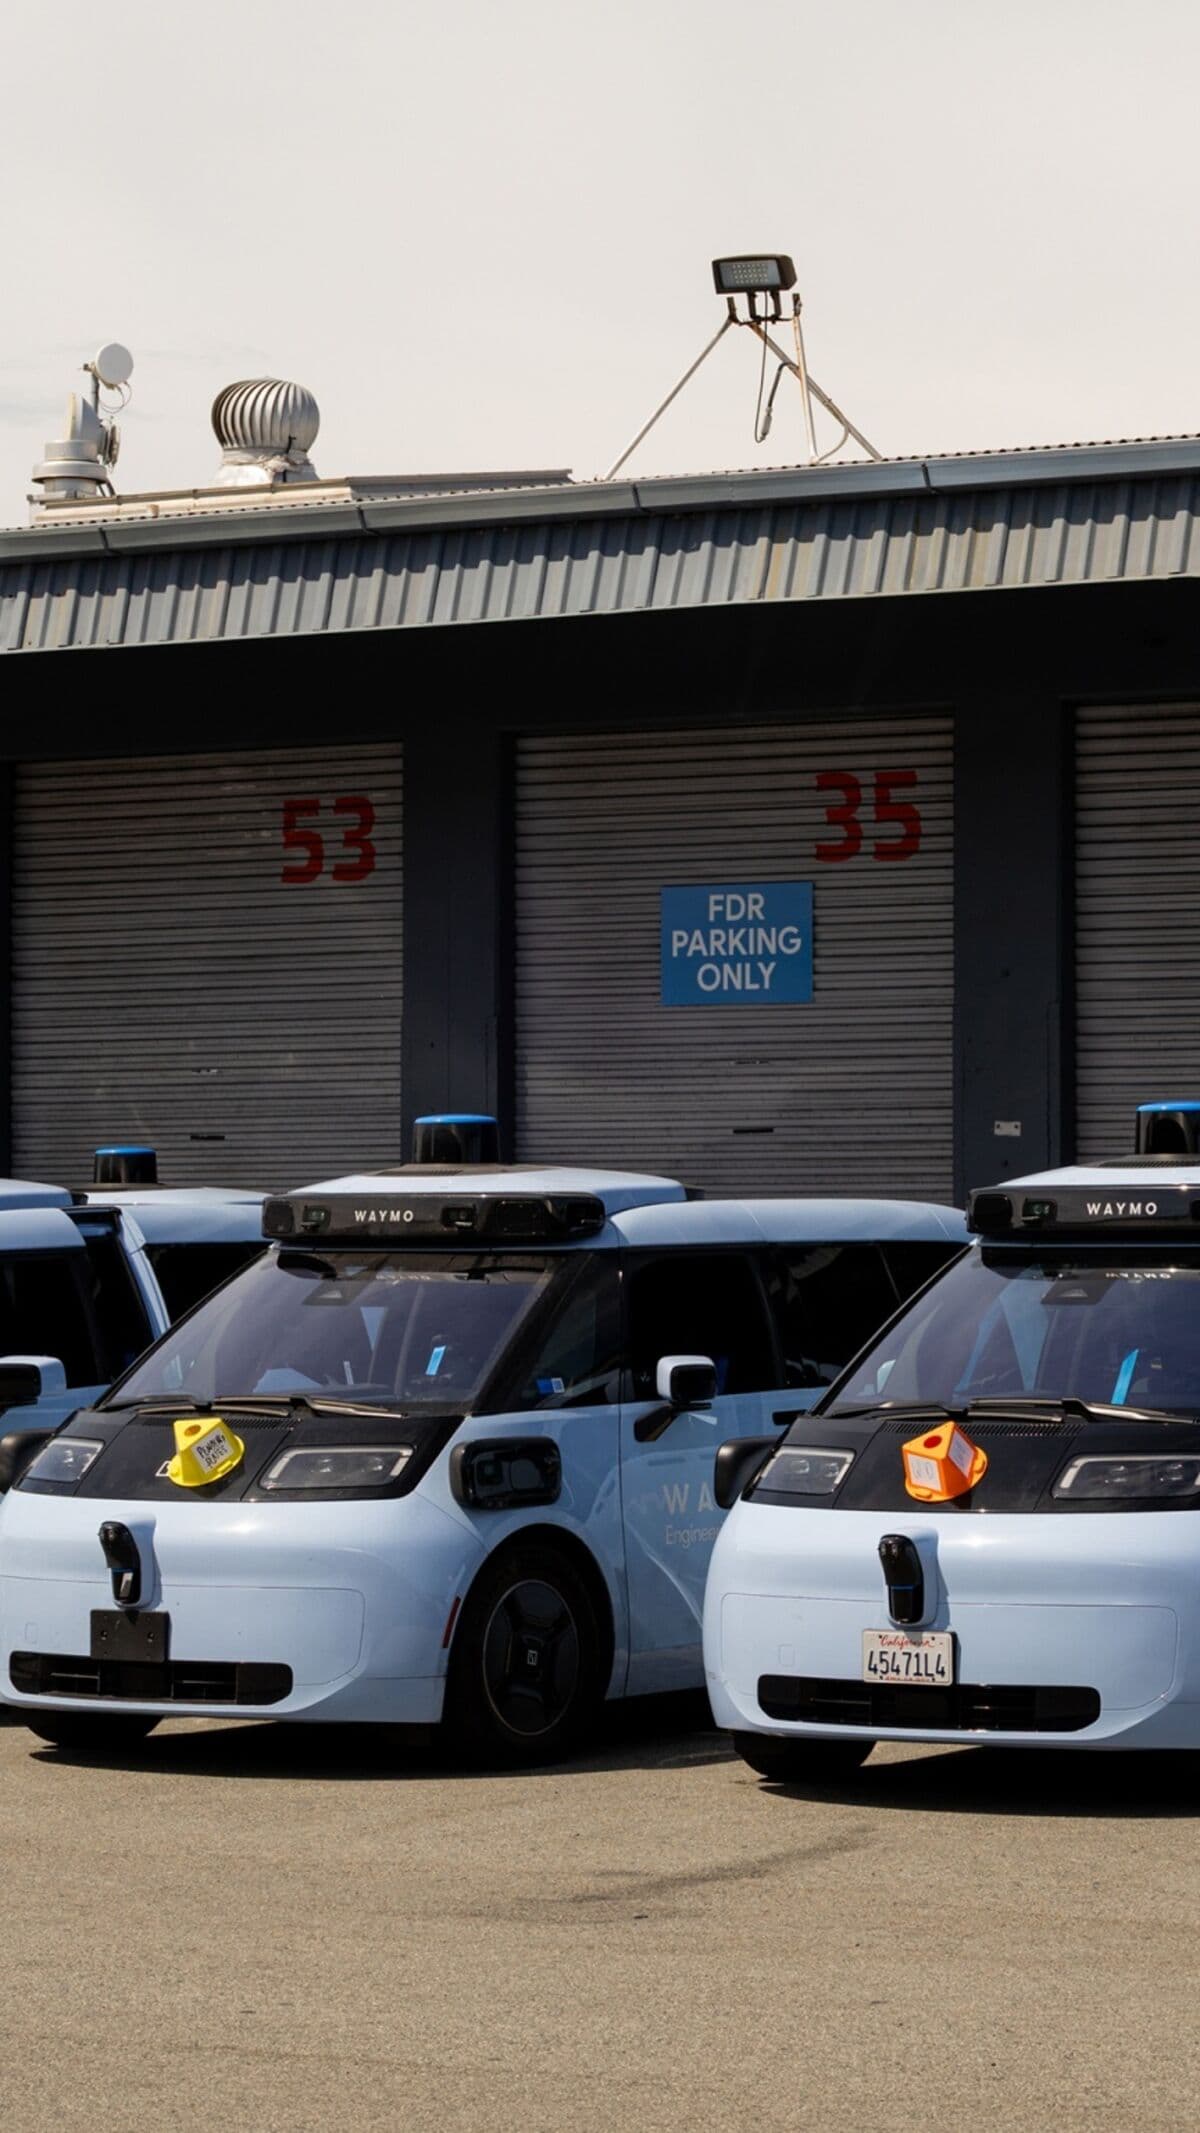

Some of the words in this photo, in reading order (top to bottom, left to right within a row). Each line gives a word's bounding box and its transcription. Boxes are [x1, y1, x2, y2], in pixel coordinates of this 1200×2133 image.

[815, 770, 922, 863] 35
[281, 796, 376, 883] 53
[708, 893, 765, 922] FDR
[671, 926, 802, 958] PARKING
[697, 961, 776, 992] ONLY
[354, 1209, 414, 1223] WAYMO
[1086, 1202, 1158, 1216] WAYMO
[867, 1650, 946, 1678] 45471L4
